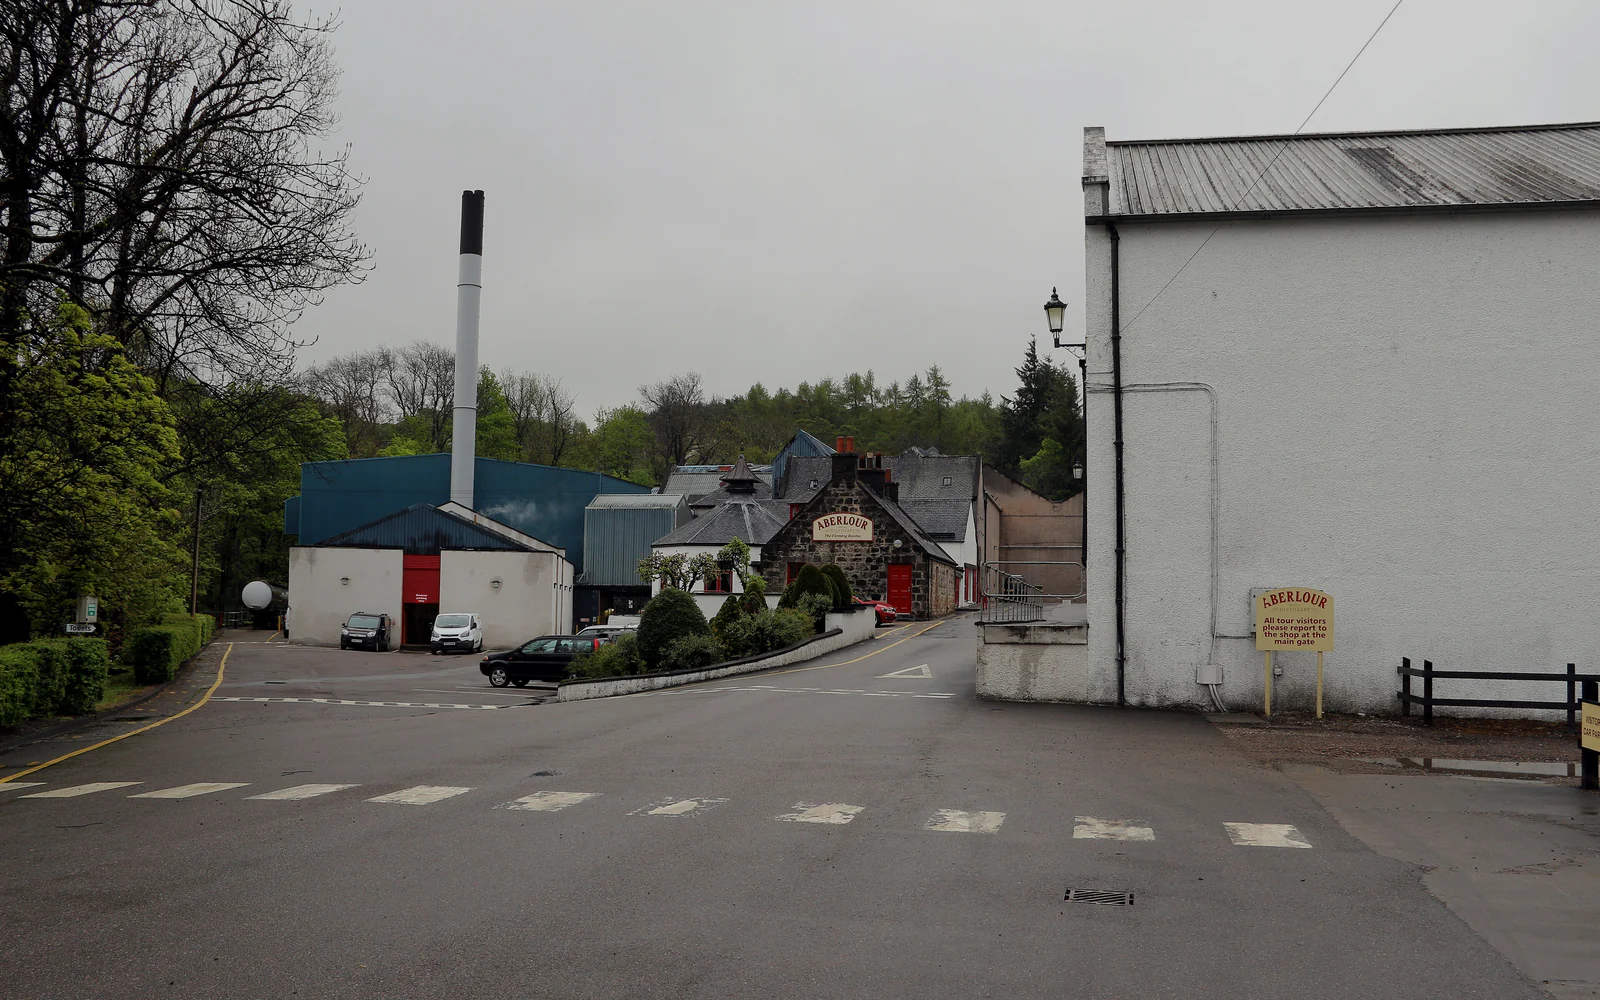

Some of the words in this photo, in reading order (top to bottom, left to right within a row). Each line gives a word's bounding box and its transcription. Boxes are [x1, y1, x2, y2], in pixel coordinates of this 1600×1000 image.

[817, 516, 868, 530] ABERLOUR
[1262, 590, 1328, 608] ABERLOUR
[1583, 727, 1591, 738] CAR
[1592, 729, 1600, 740] PAR
